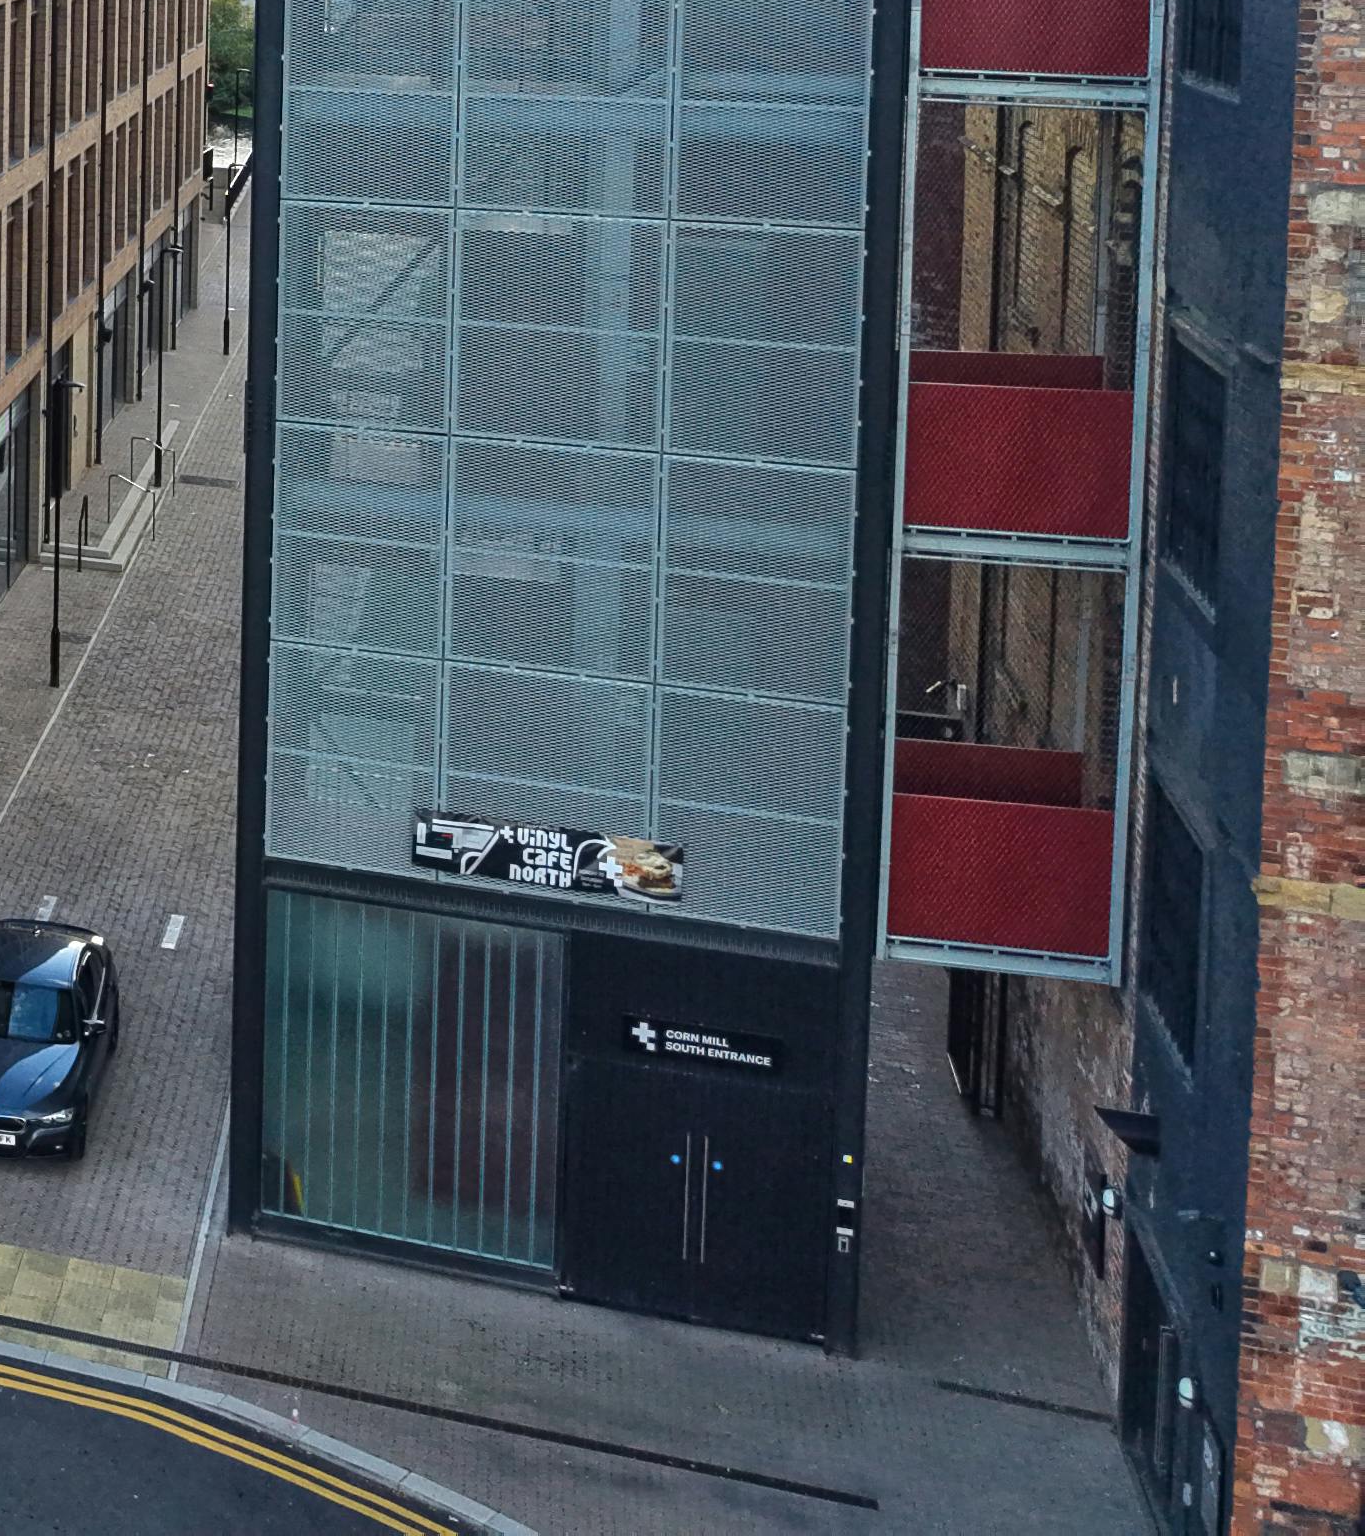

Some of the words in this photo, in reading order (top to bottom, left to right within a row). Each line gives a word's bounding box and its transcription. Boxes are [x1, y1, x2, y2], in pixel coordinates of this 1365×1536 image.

[665, 1029, 699, 1043] CORN
[702, 1035, 729, 1048] MILL
[665, 1041, 705, 1056] SOUTH
[707, 1048, 772, 1067] ENTRANCE
